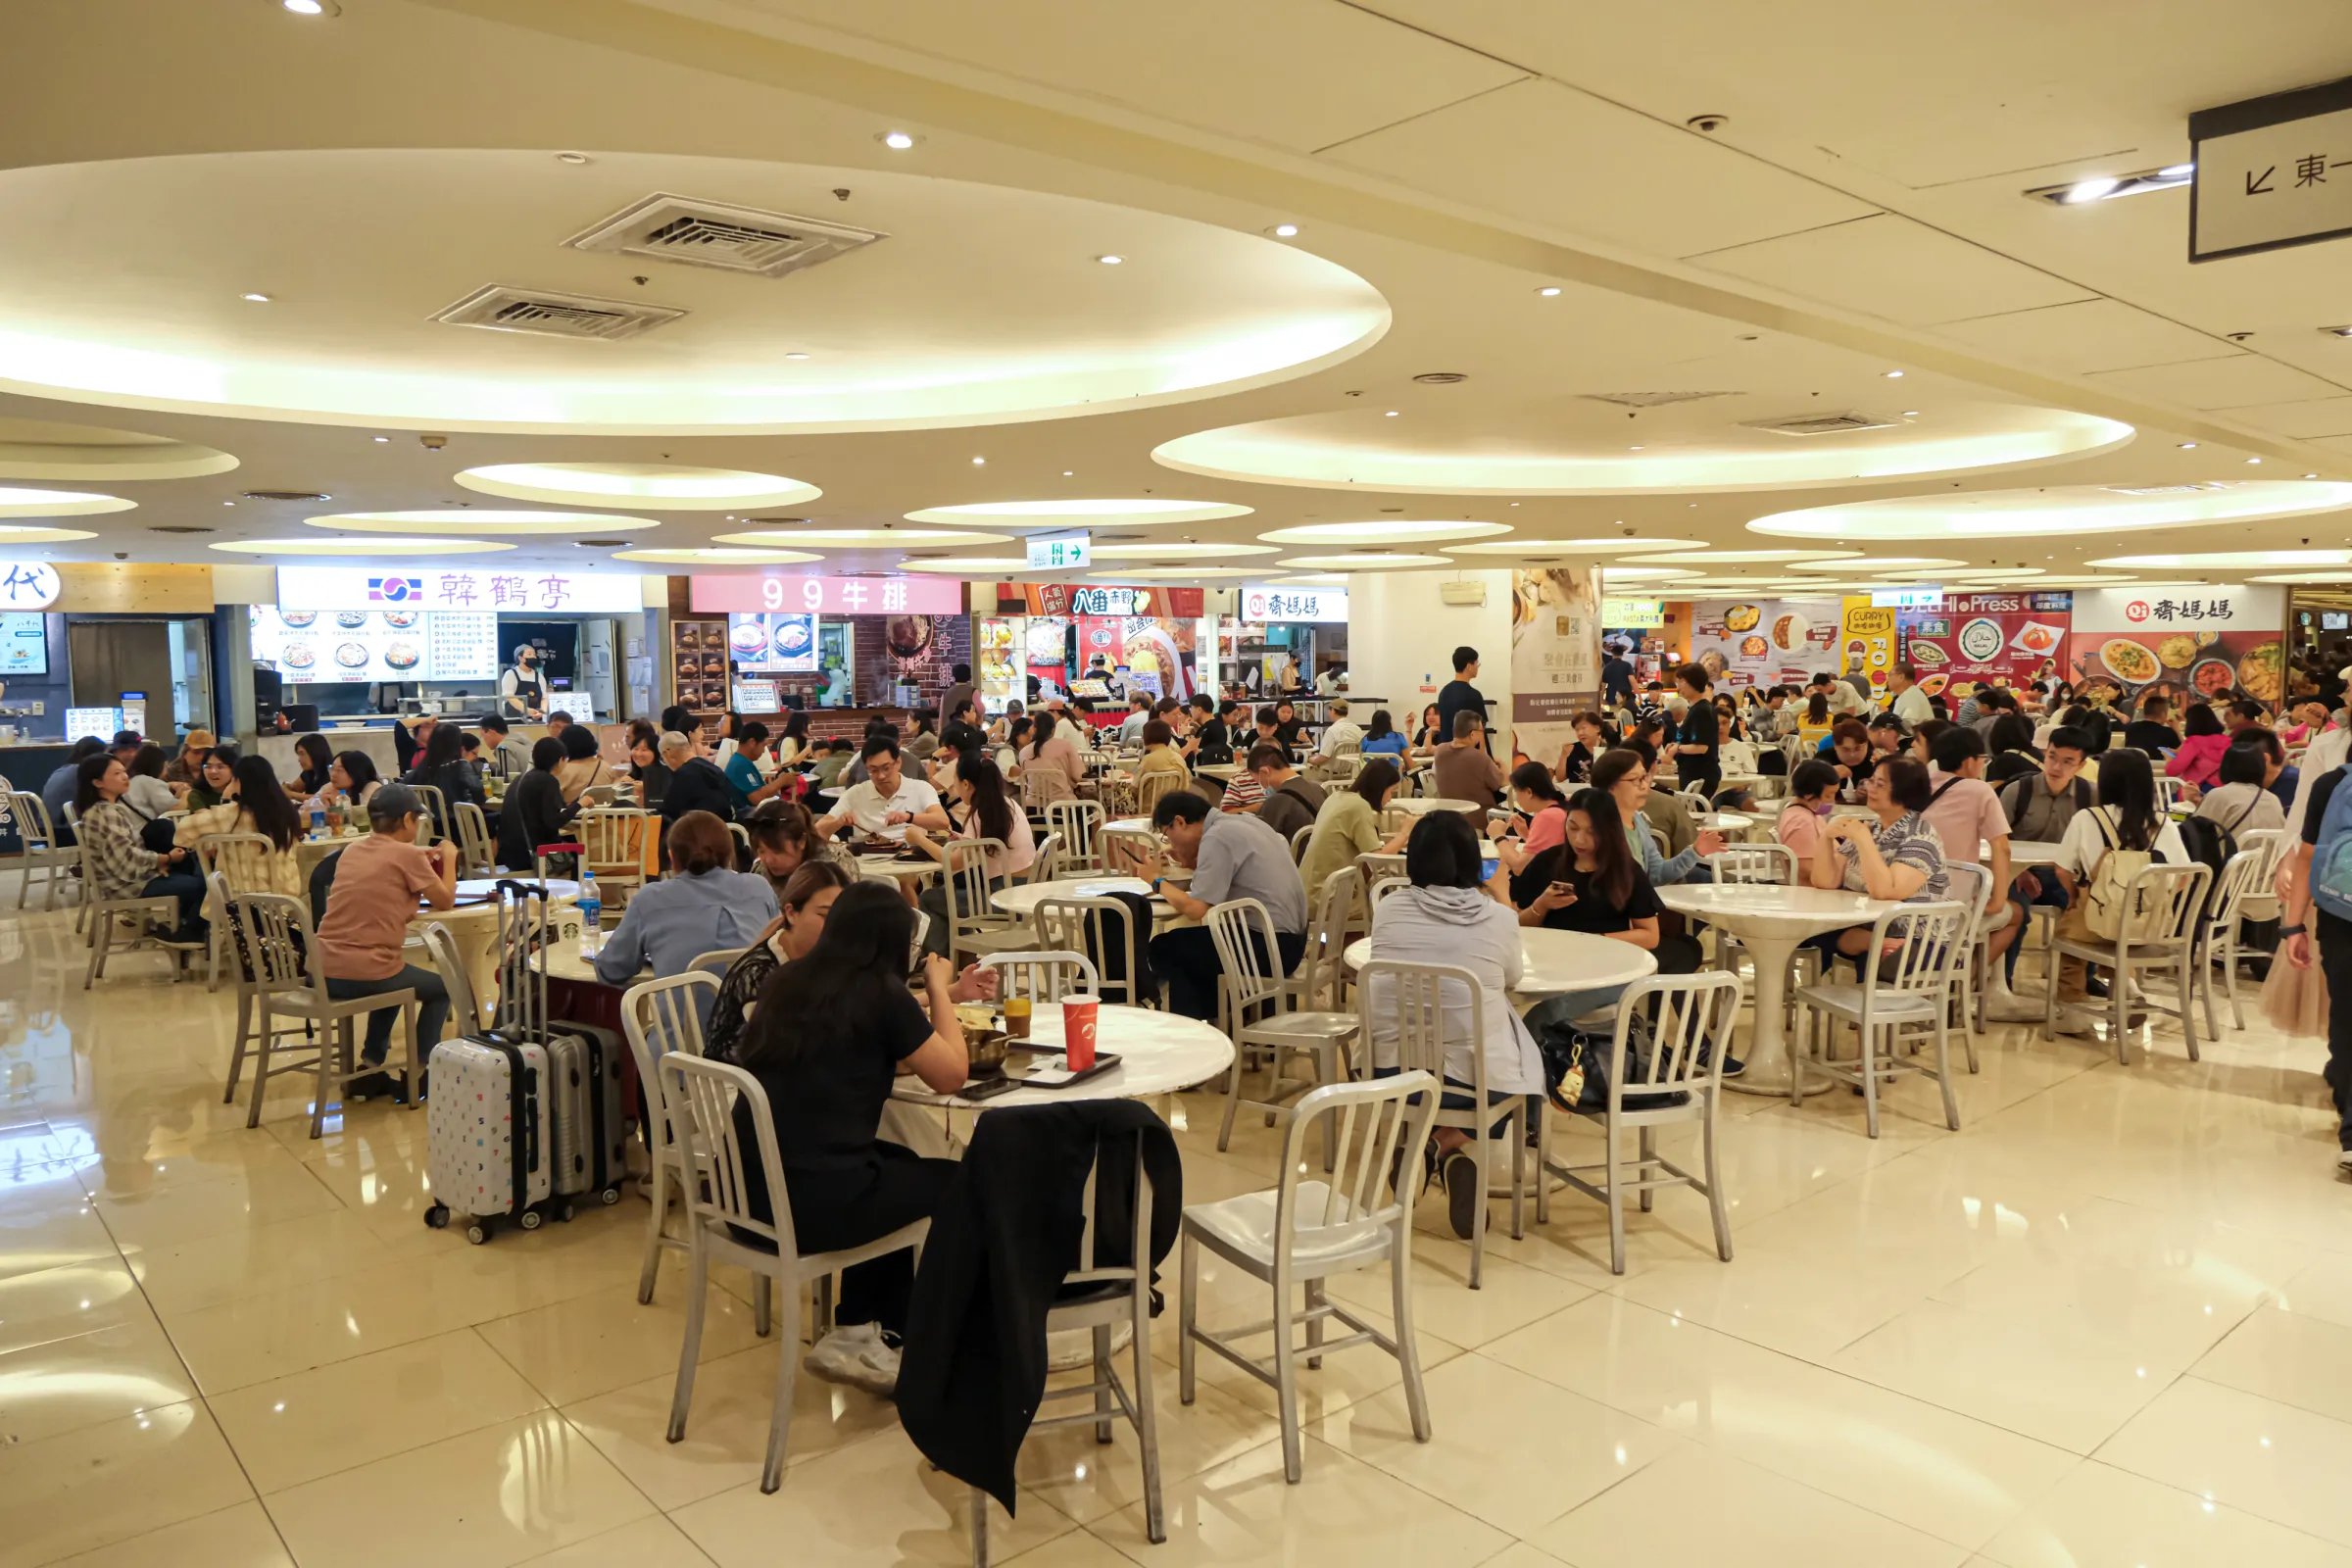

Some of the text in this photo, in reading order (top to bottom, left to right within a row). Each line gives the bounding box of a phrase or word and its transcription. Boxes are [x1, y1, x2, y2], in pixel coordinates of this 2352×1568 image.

[3, 564, 46, 600] 代
[438, 573, 570, 610] 韓鶴亭
[1268, 594, 1319, 616] 齊媽媽
[1971, 595, 2019, 612] Press
[2128, 604, 2148, 619] Qi
[2153, 599, 2233, 621] 齊媽媽
[1854, 612, 1884, 620] CURRY
[1922, 621, 1944, 633] 素食
